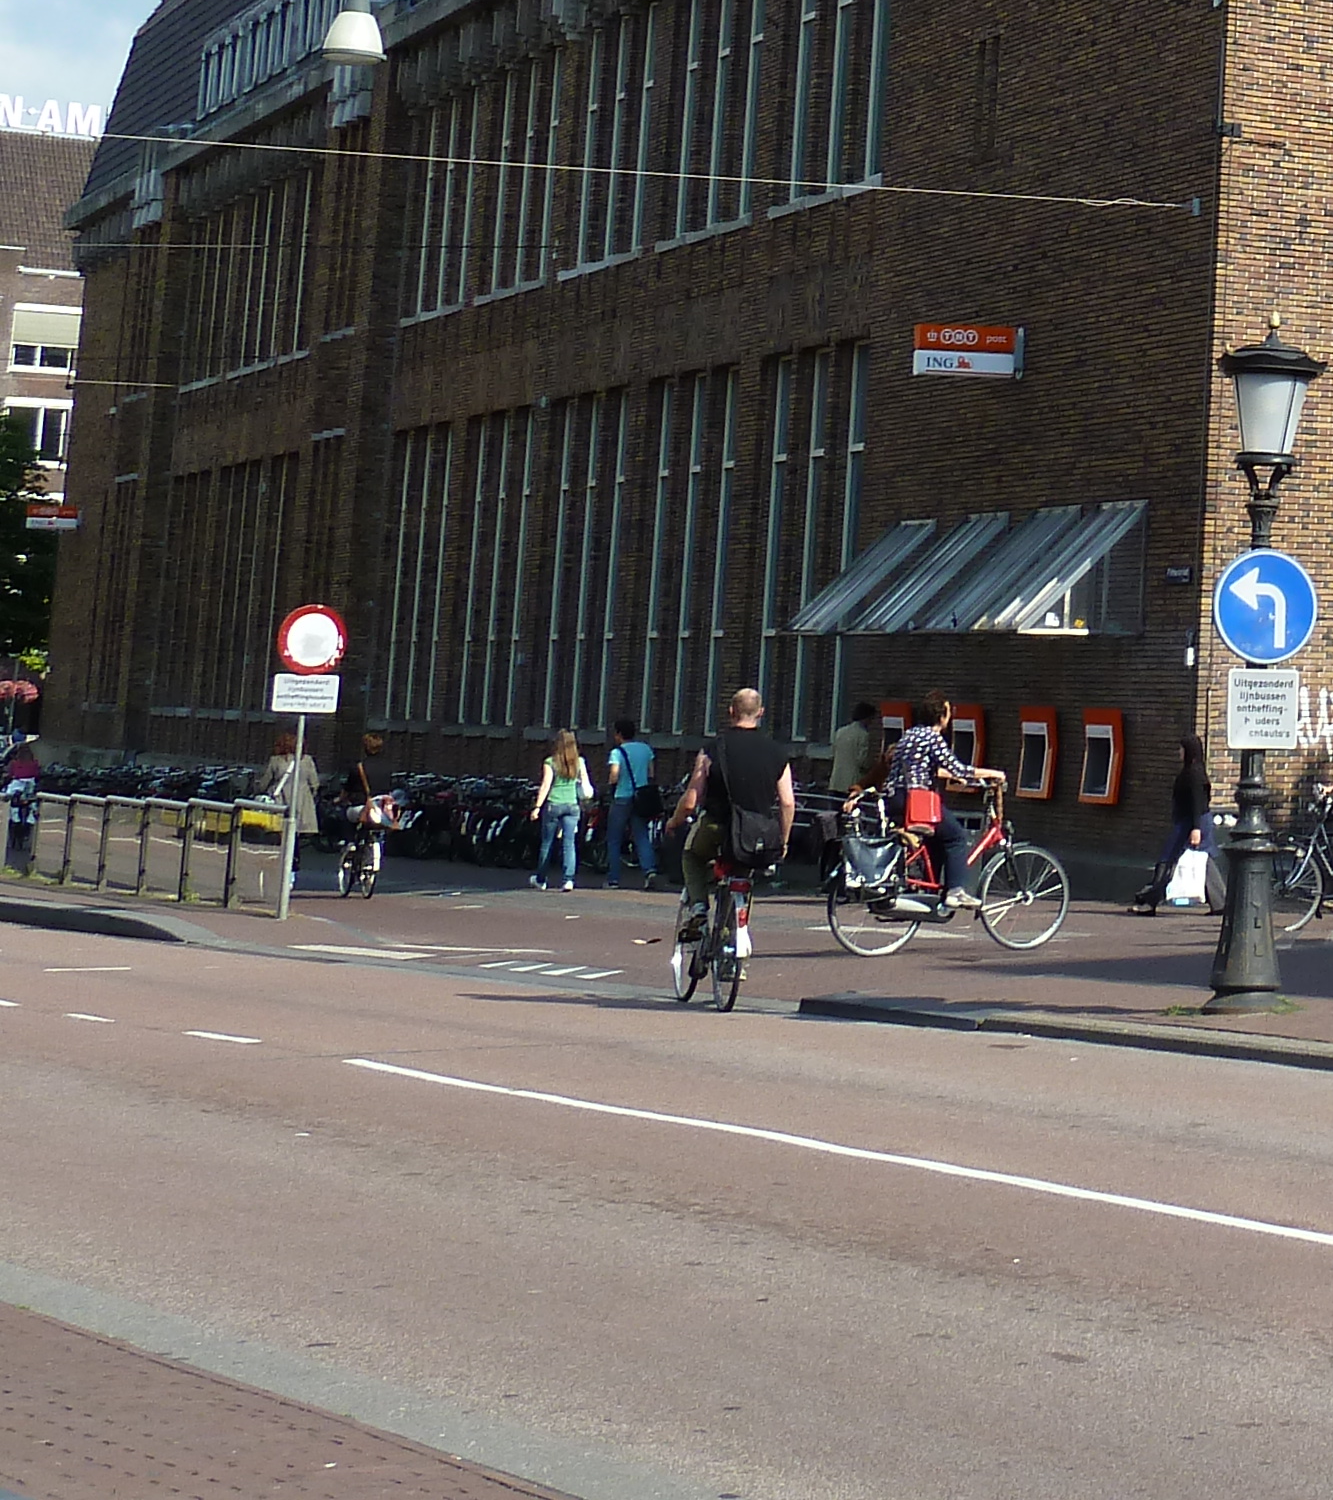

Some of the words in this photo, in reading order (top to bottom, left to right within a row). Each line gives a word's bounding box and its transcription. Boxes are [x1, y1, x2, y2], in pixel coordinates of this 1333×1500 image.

[942, 330, 977, 343] TNT
[986, 336, 1007, 344] post
[926, 356, 954, 369] ING
[1234, 678, 1294, 690] Uitgezonderd
[1239, 691, 1286, 702] lijnbussen
[1236, 704, 1288, 715] ontheffing-
